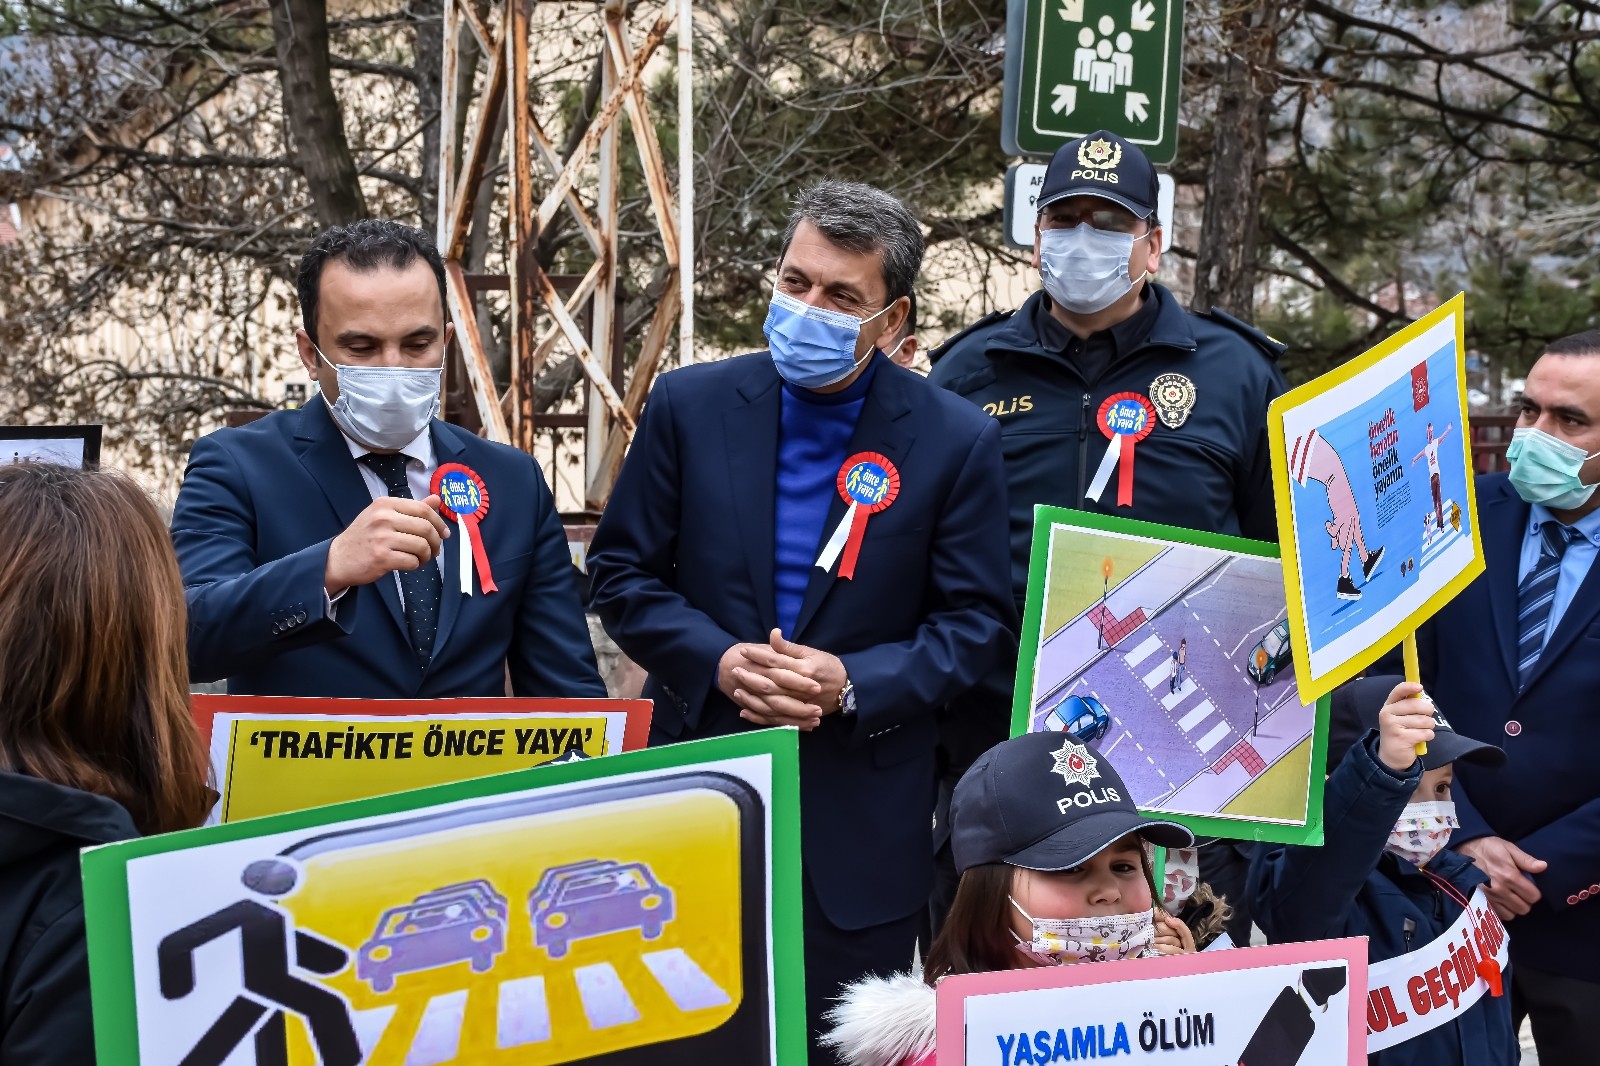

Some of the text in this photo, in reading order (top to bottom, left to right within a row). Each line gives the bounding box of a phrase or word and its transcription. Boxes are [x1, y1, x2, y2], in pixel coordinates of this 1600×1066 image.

[1030, 176, 1043, 186] AF
[982, 395, 1034, 417] OLİS
[1120, 405, 1136, 419] önce
[1117, 418, 1133, 430] yaya
[1368, 407, 1396, 441] öncelik
[1369, 429, 1399, 460] hayatın
[862, 468, 880, 487] önce
[1372, 447, 1400, 479] öncelik
[856, 482, 875, 498] yaya
[1374, 464, 1404, 502] yayanın
[423, 725, 506, 757] ÖNCE
[1367, 986, 1409, 1035] UL
[1407, 927, 1482, 1016] GEÇİDİ
[996, 1007, 1216, 1066] YAŞAMLA ÖLÜM
